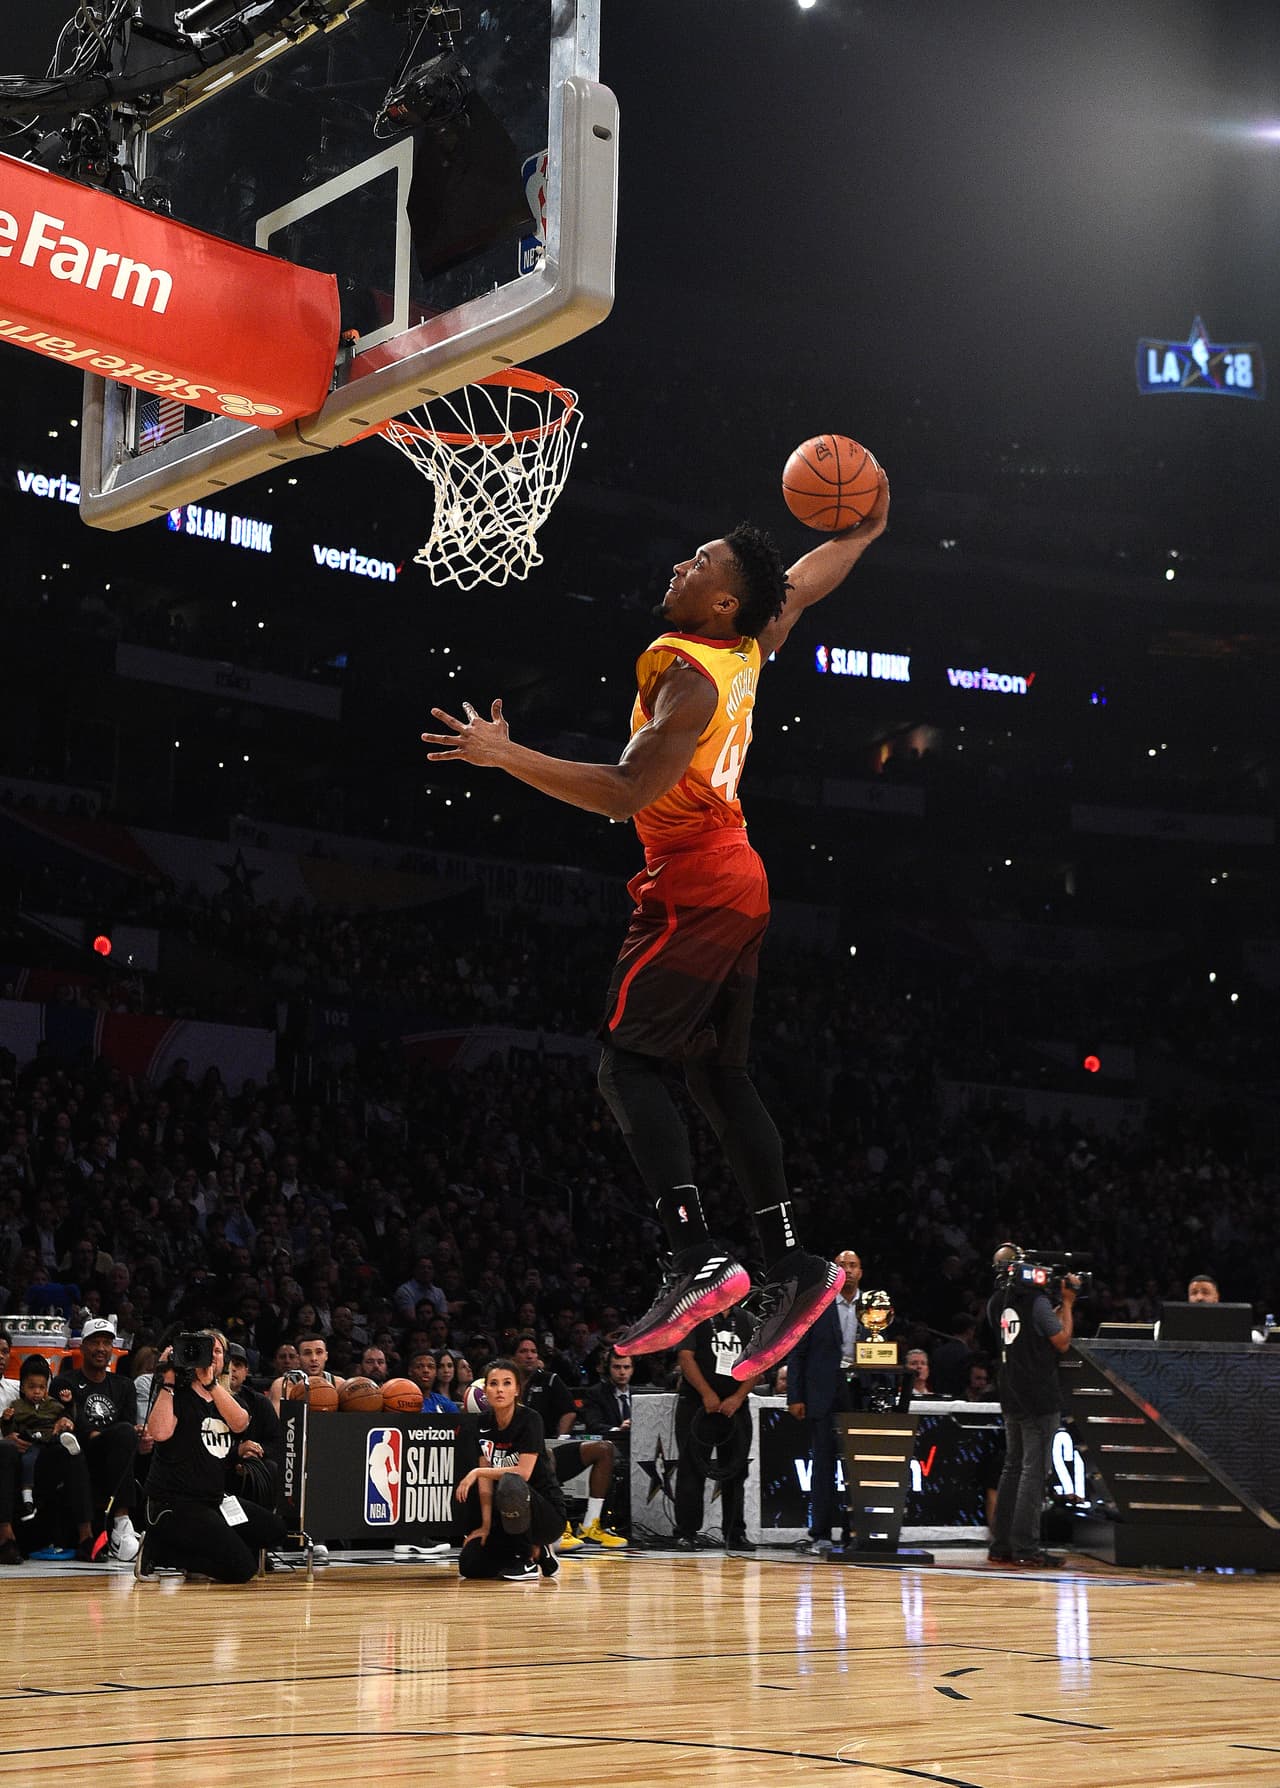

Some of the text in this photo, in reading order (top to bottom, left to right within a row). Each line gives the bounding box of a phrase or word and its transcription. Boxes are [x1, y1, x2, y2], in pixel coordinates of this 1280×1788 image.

[1147, 349, 1181, 384] LA
[16, 470, 80, 505] veriz
[186, 504, 273, 554] SLAM DUNK
[312, 543, 397, 583] verizon
[830, 647, 911, 683] SLAM DUNK
[947, 666, 1028, 695] verizon
[407, 1425, 455, 1441] verizon
[284, 1416, 297, 1498] verizon
[406, 1446, 455, 1486] SLAM
[369, 1503, 387, 1520] NBA
[404, 1486, 453, 1523] DUNK
